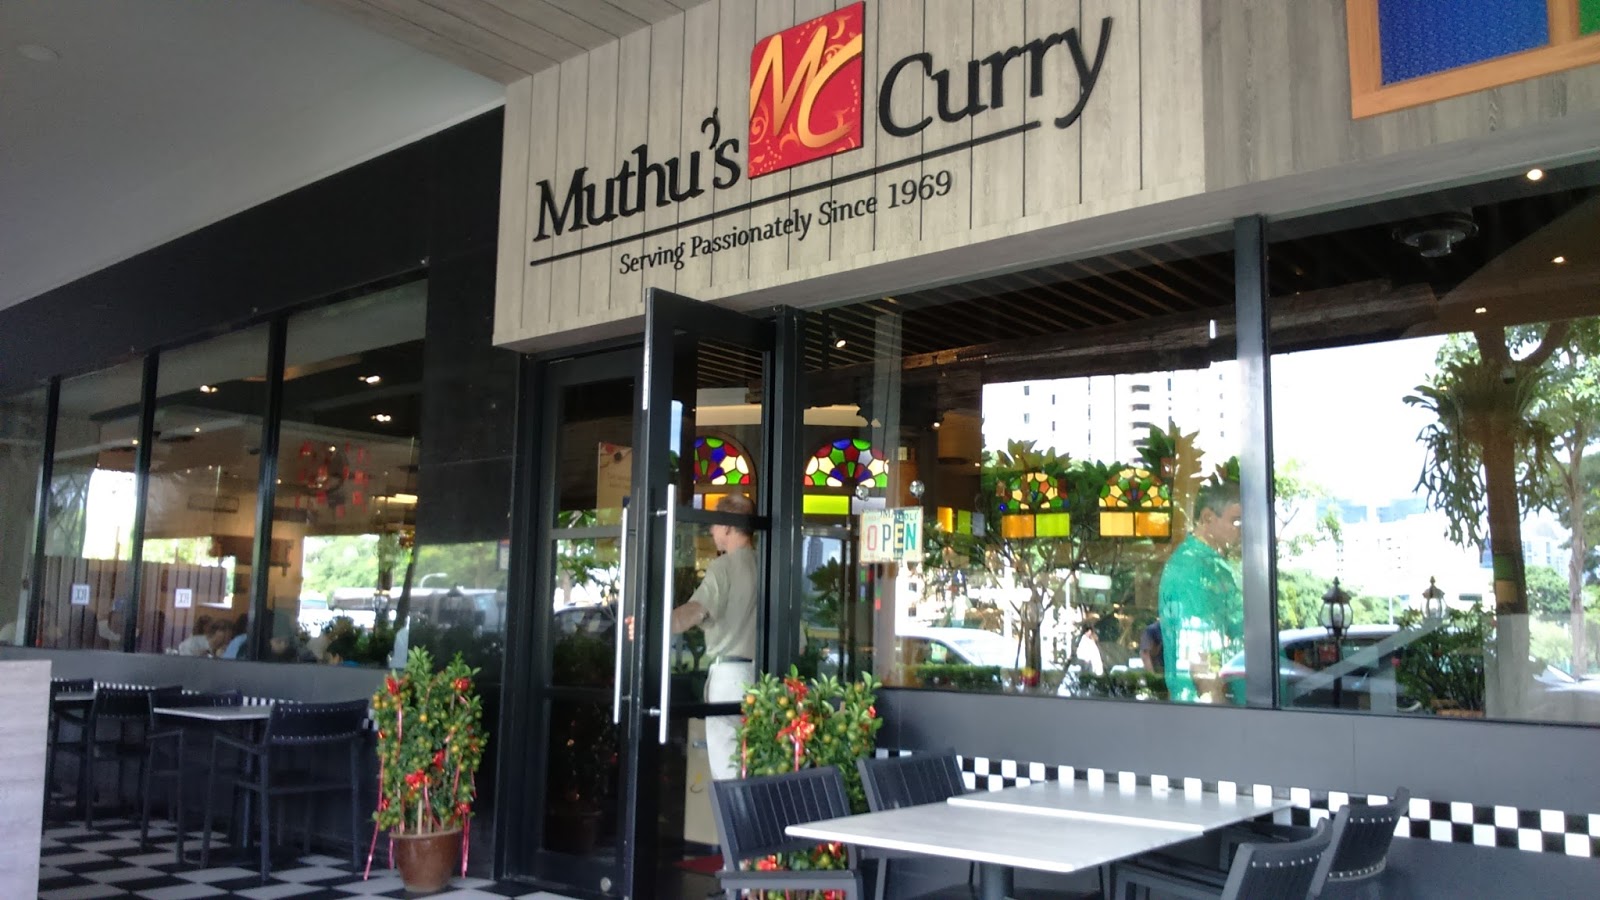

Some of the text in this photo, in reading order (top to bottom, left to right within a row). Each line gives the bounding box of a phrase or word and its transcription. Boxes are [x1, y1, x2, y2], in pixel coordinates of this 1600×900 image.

[533, 16, 1112, 242] Muthu's Curry
[619, 170, 952, 274] Serving Passionately Since 1969
[867, 523, 917, 552] OPEN
